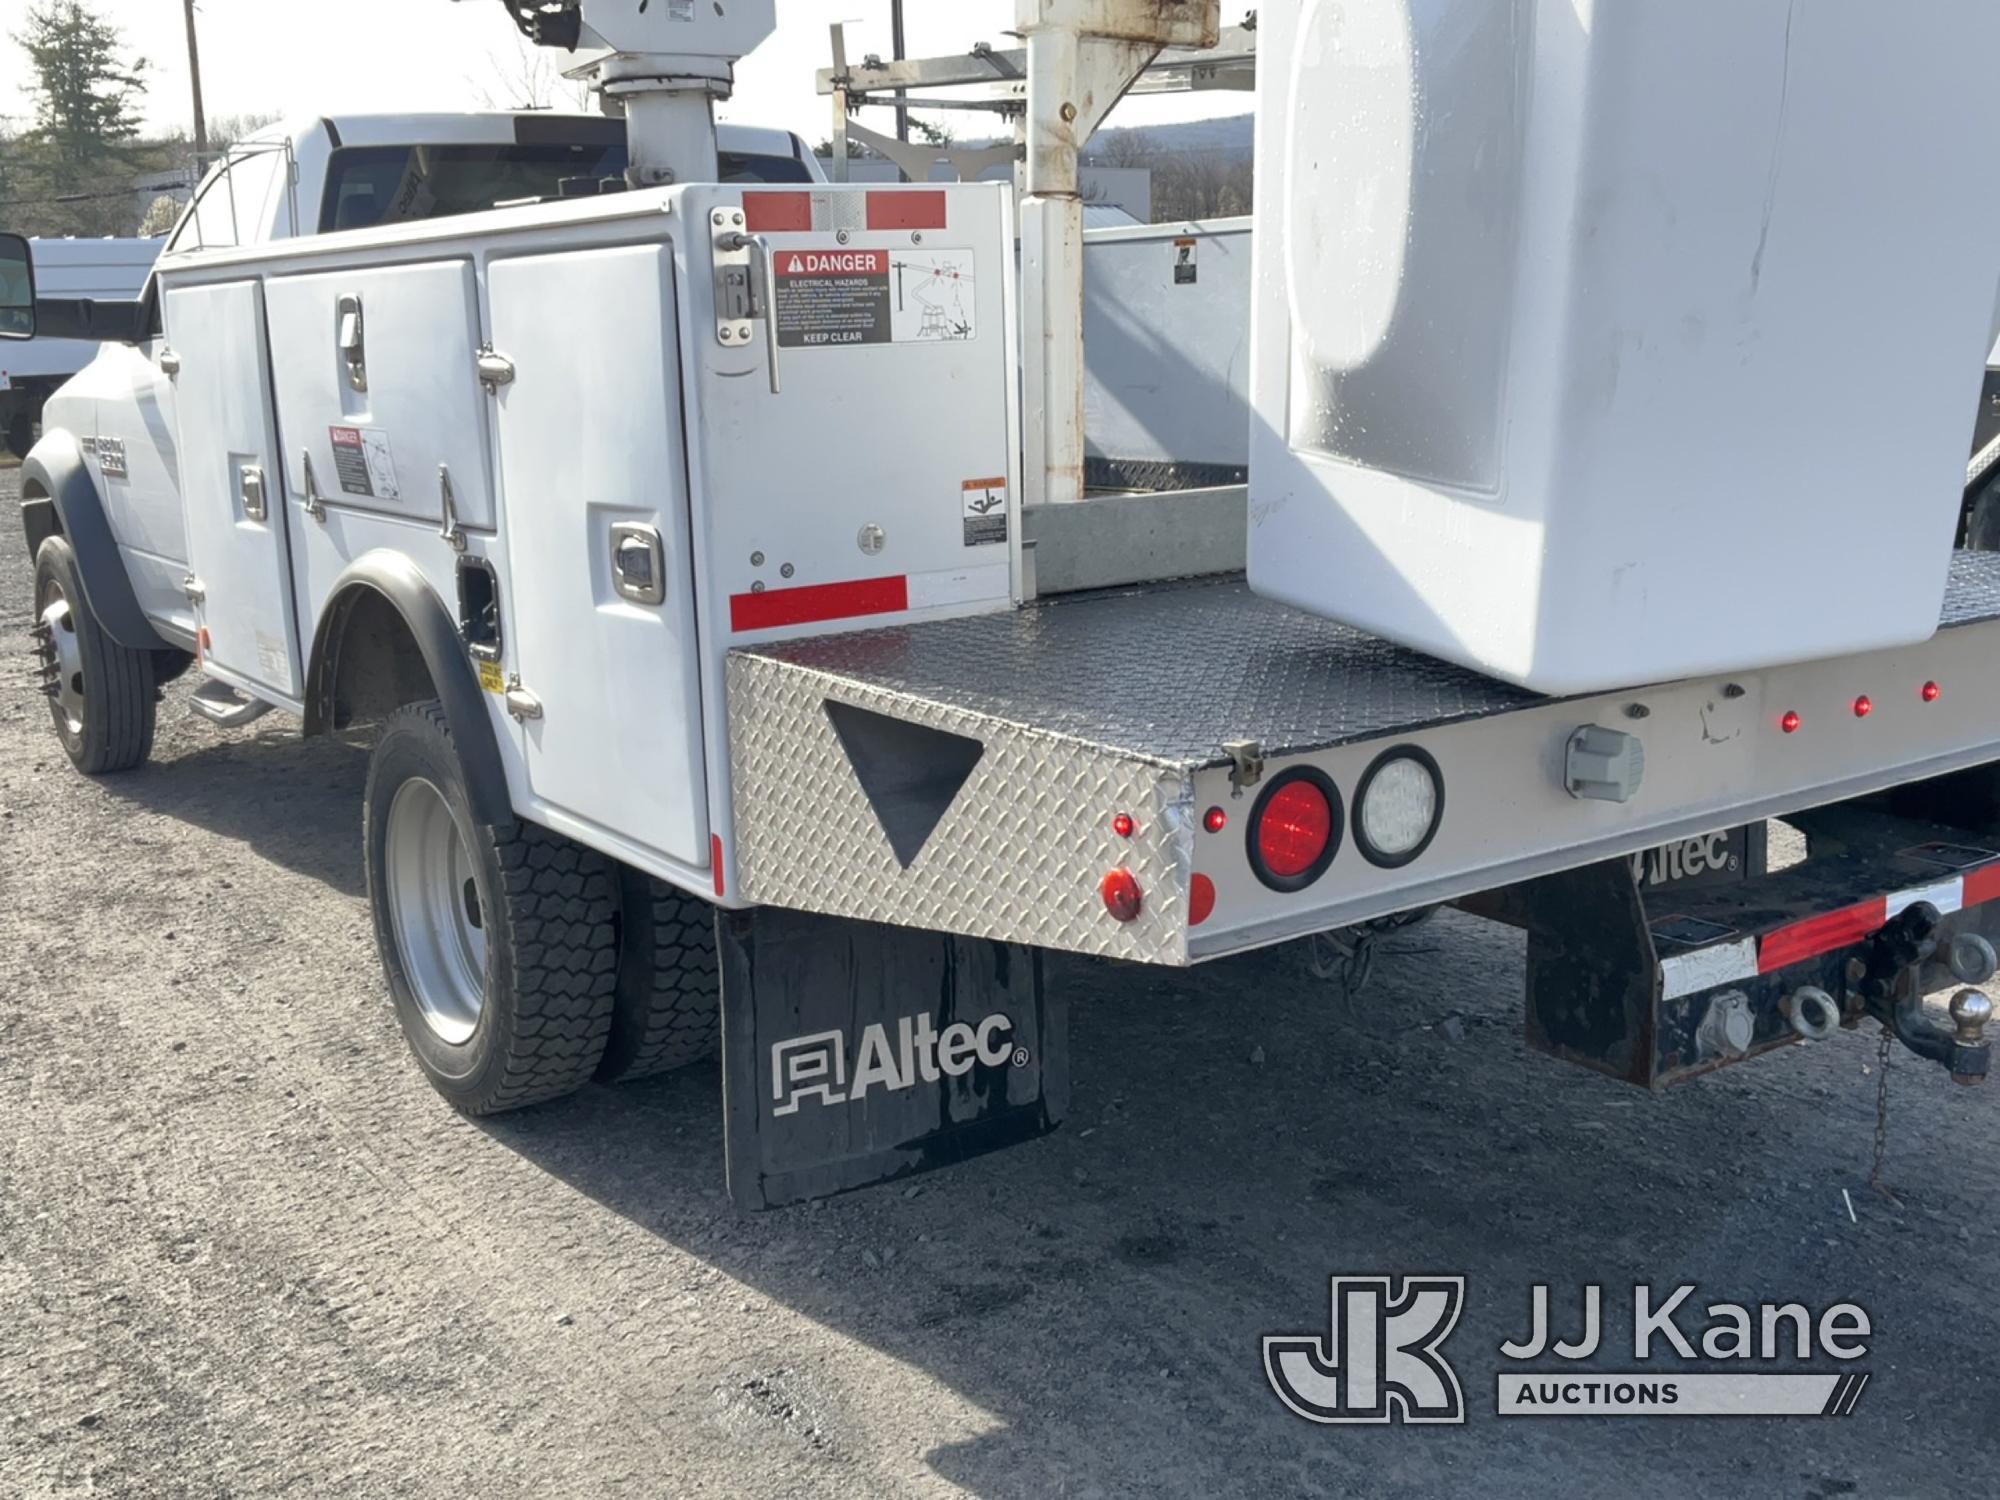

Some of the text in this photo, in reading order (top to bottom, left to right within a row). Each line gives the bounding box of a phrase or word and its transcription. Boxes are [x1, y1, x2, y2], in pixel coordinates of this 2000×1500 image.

[806, 254, 877, 272] DANGER
[789, 278, 868, 288] ELECTRICAL HAZARDS
[803, 331, 863, 344] KEEP CLEAR
